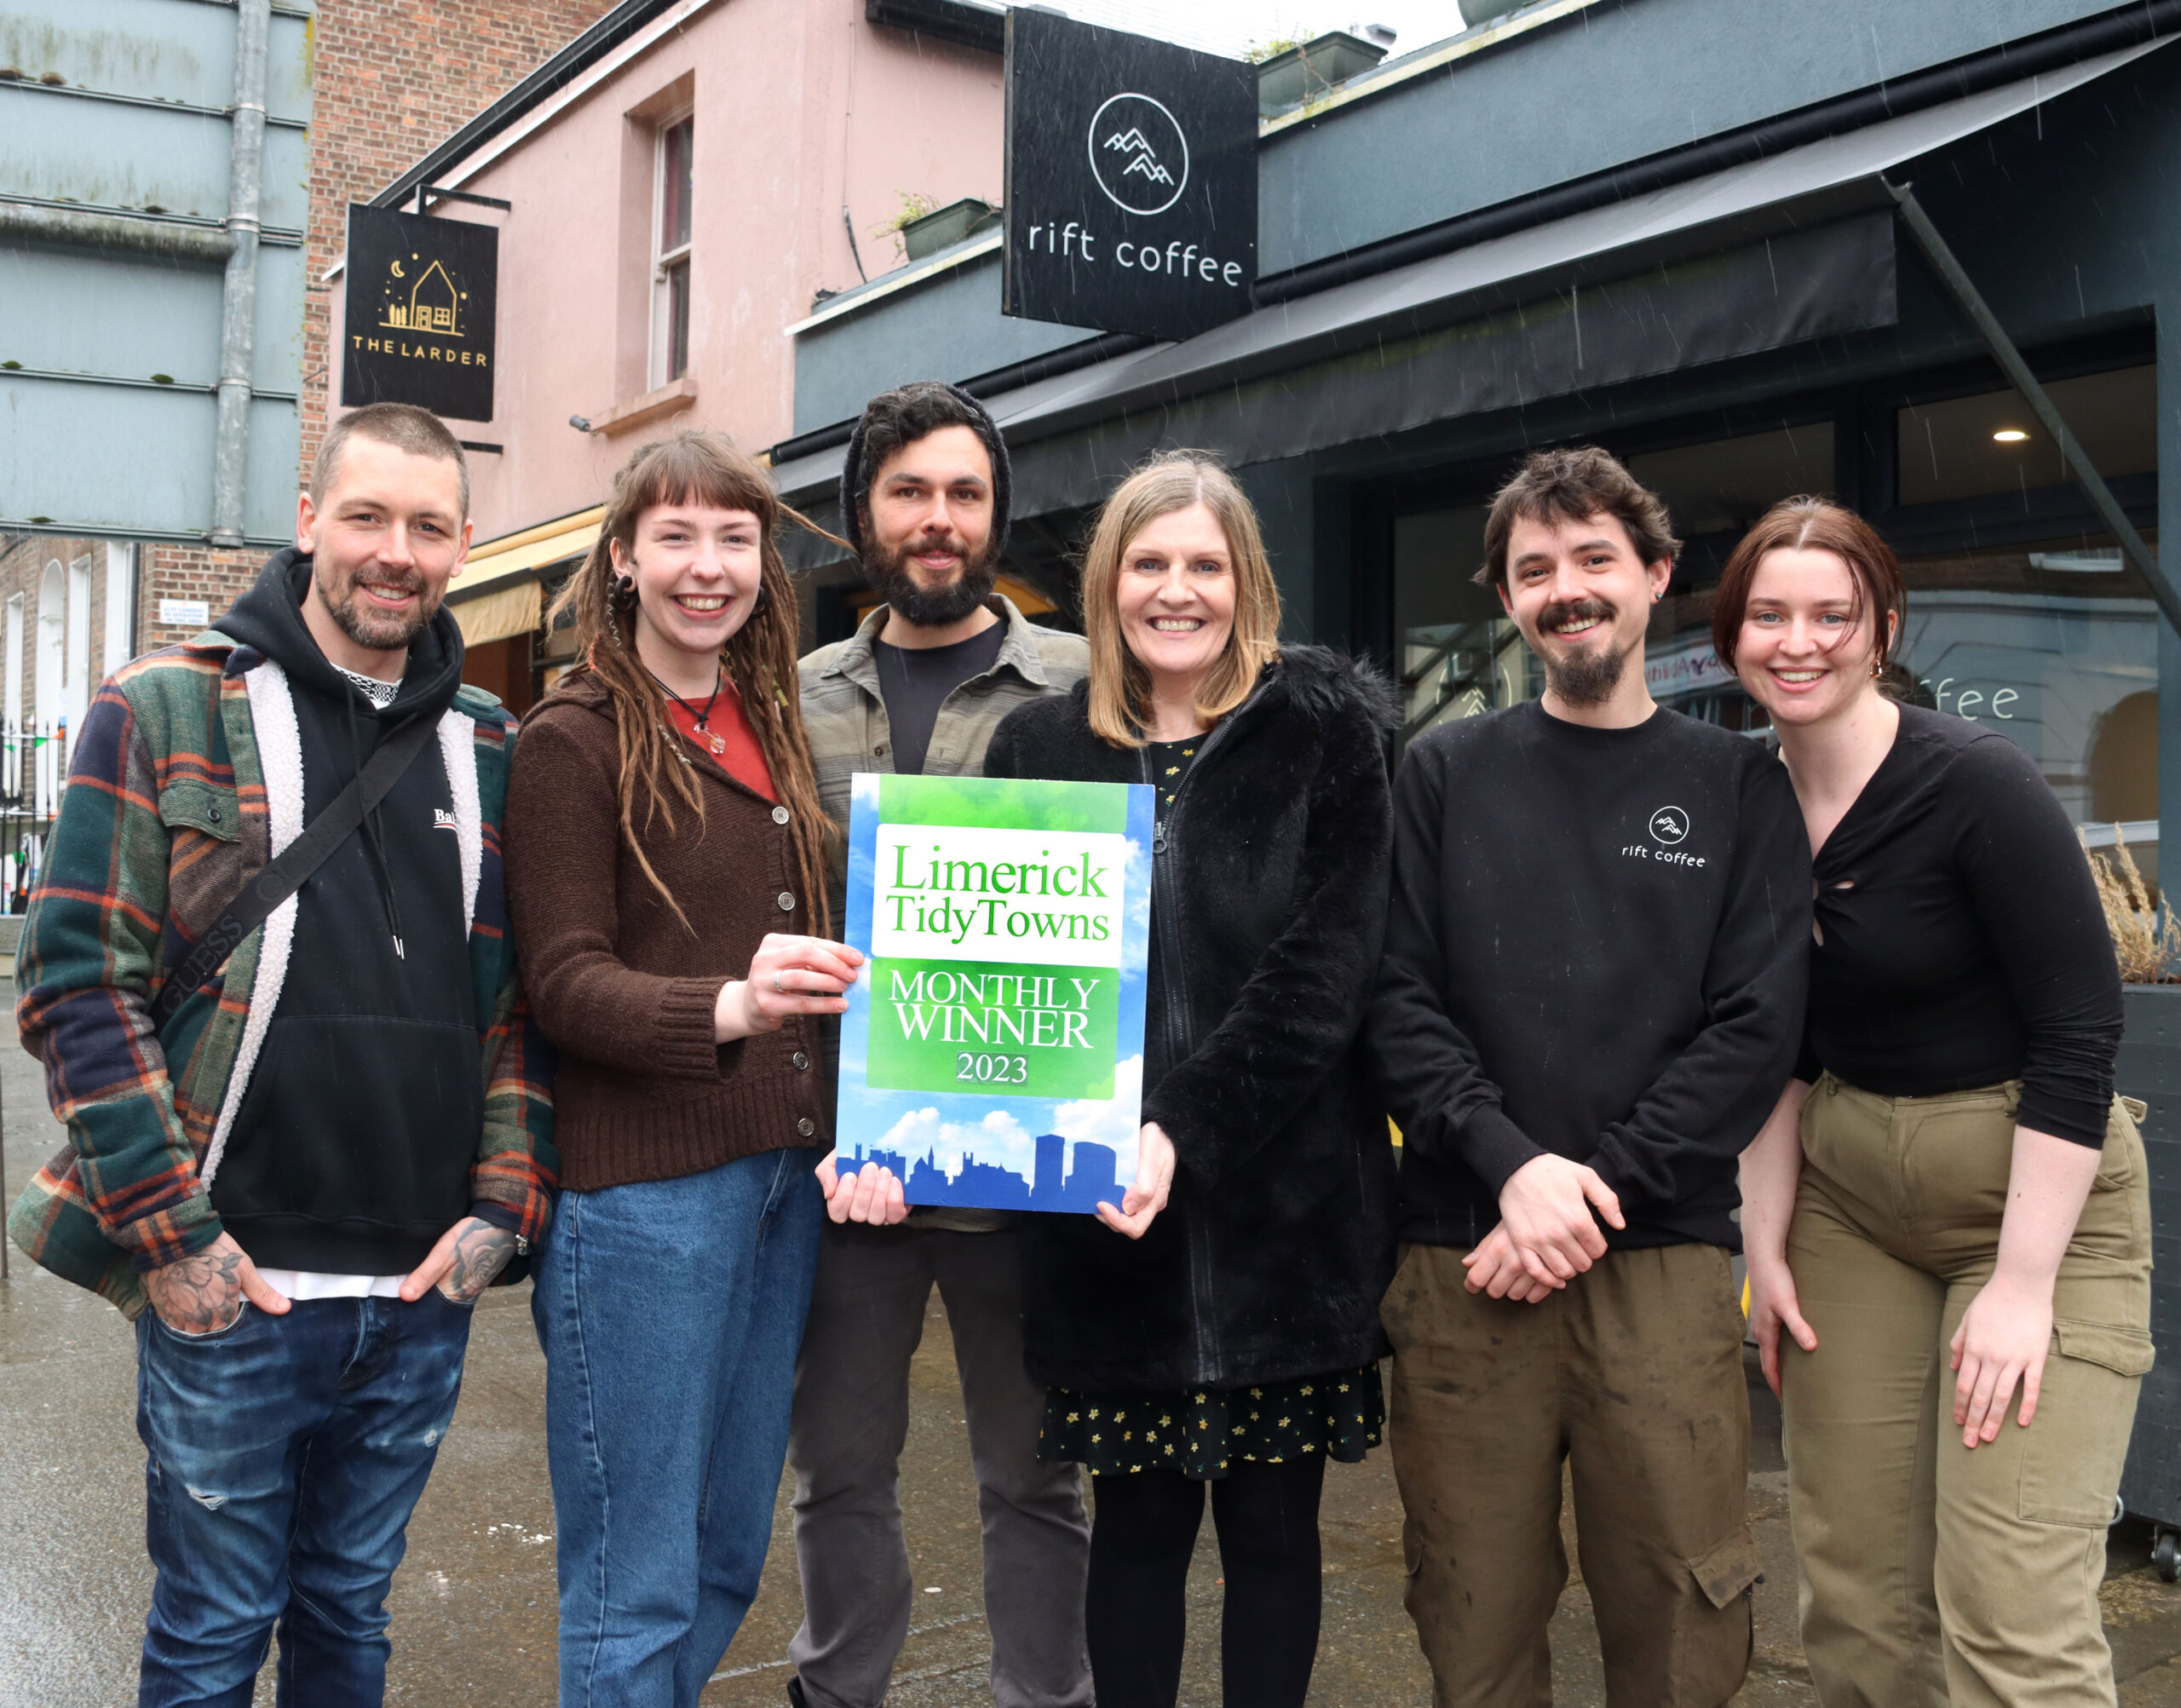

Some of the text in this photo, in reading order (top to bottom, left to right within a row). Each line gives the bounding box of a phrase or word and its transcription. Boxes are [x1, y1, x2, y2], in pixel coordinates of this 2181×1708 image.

[1029, 221, 1243, 287] rift coffee
[889, 844, 1109, 898] Limerick
[1621, 845, 1706, 867] rift coffee
[885, 894, 1110, 945] TidyTowns
[161, 912, 245, 1015] GUESS
[888, 969, 1102, 1010] MONTHLY
[892, 1002, 1095, 1050] WINNER
[955, 1052, 1028, 1084] 2023
